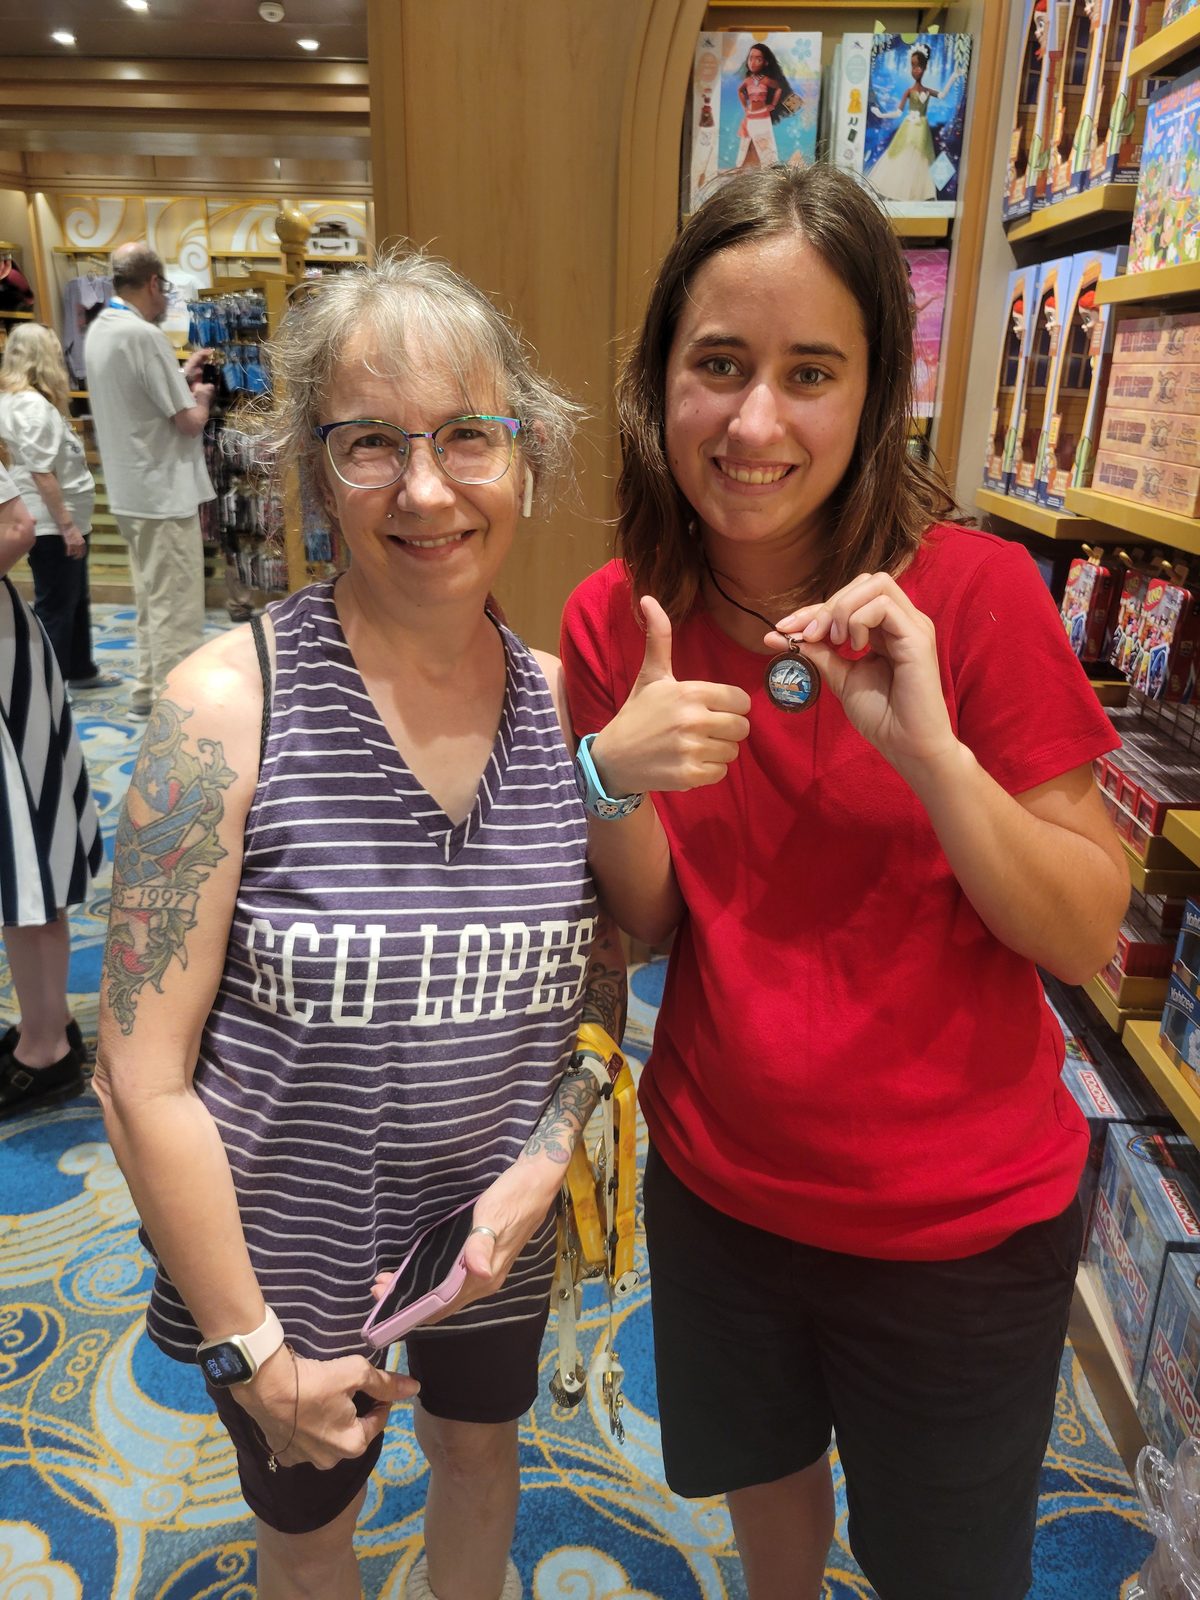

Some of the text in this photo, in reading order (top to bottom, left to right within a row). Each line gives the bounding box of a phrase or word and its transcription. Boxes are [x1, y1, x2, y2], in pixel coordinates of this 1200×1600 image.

[247, 915, 598, 1027] GCU LOPES
[1170, 987, 1195, 1013] Yahtzee
[1099, 1197, 1146, 1305] MONOPOLY
